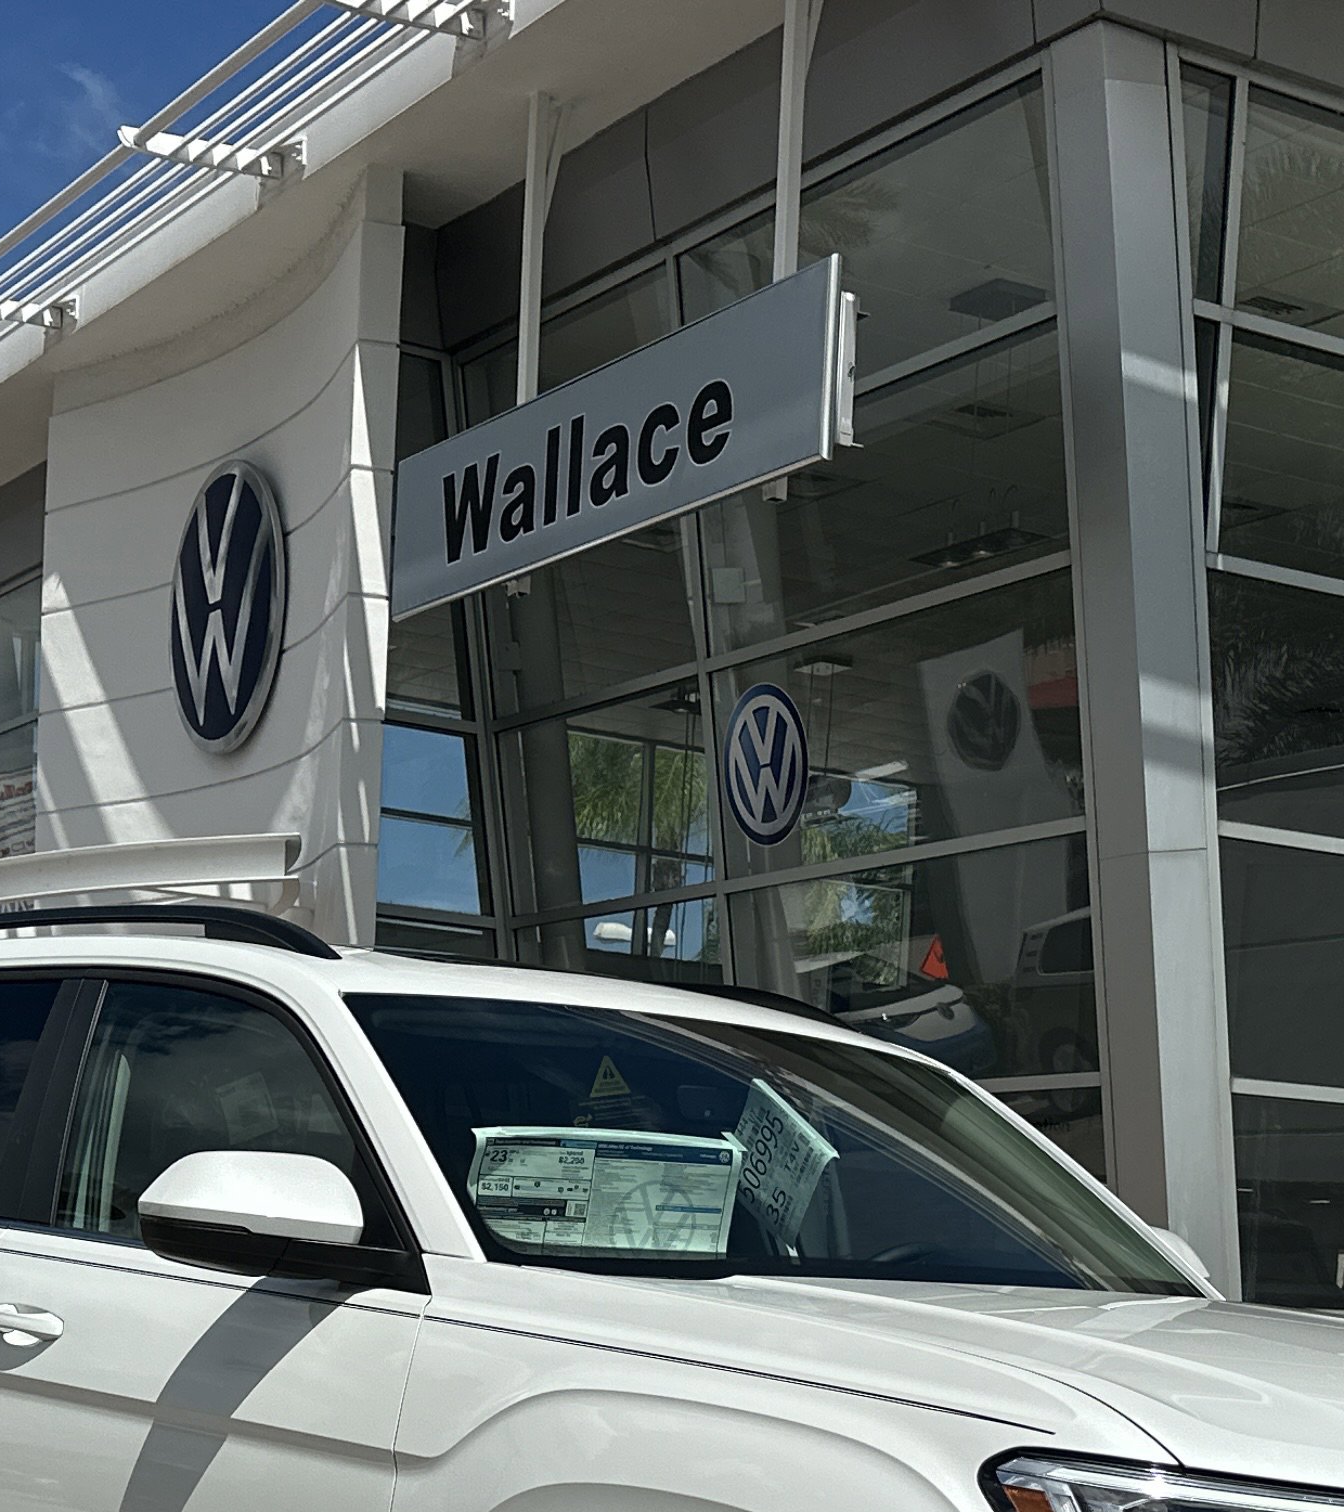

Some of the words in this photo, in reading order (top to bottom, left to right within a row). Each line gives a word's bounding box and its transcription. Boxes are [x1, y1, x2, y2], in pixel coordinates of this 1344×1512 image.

[441, 377, 734, 565] Wallace
[172, 463, 280, 744] VW
[727, 690, 804, 839] VW
[489, 1149, 509, 1163] 23
[737, 1109, 785, 1204] 506995
[765, 1186, 787, 1226] 35
